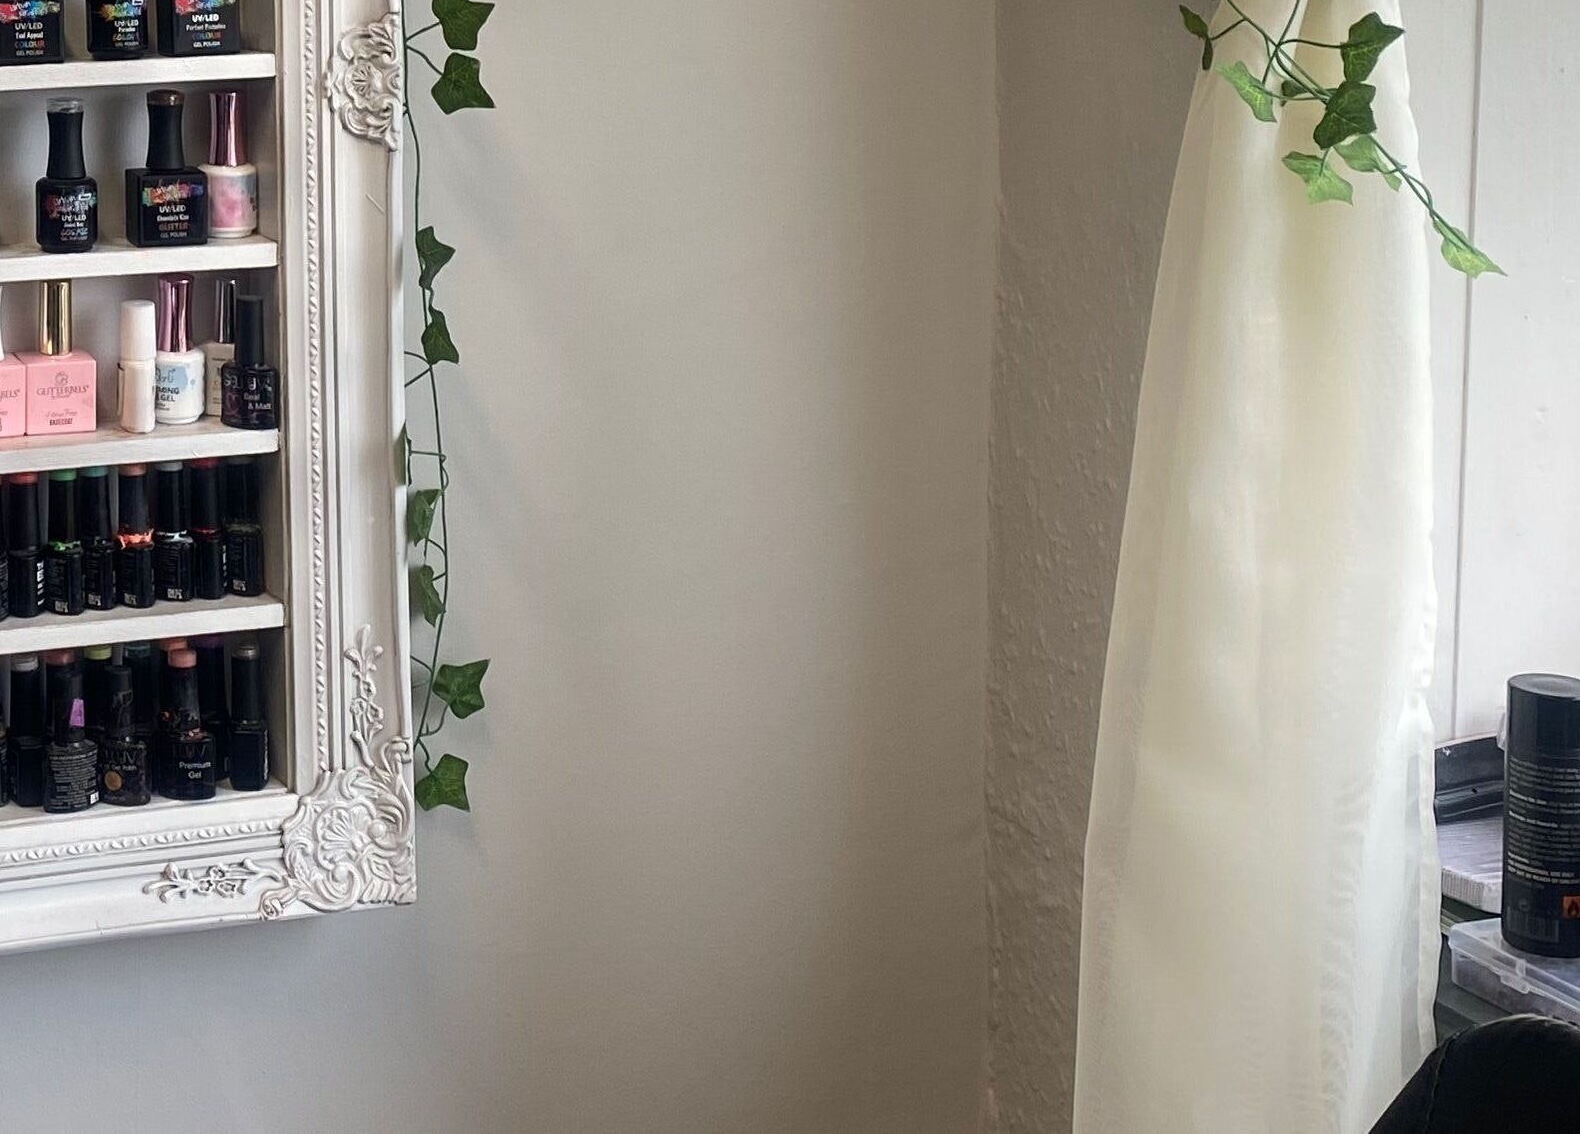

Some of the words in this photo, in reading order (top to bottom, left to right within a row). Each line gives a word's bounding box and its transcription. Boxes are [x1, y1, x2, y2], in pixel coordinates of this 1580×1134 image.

[191, 14, 220, 23] UV/LED
[14, 23, 43, 31] UV/LED
[179, 761, 211, 770] Premium
